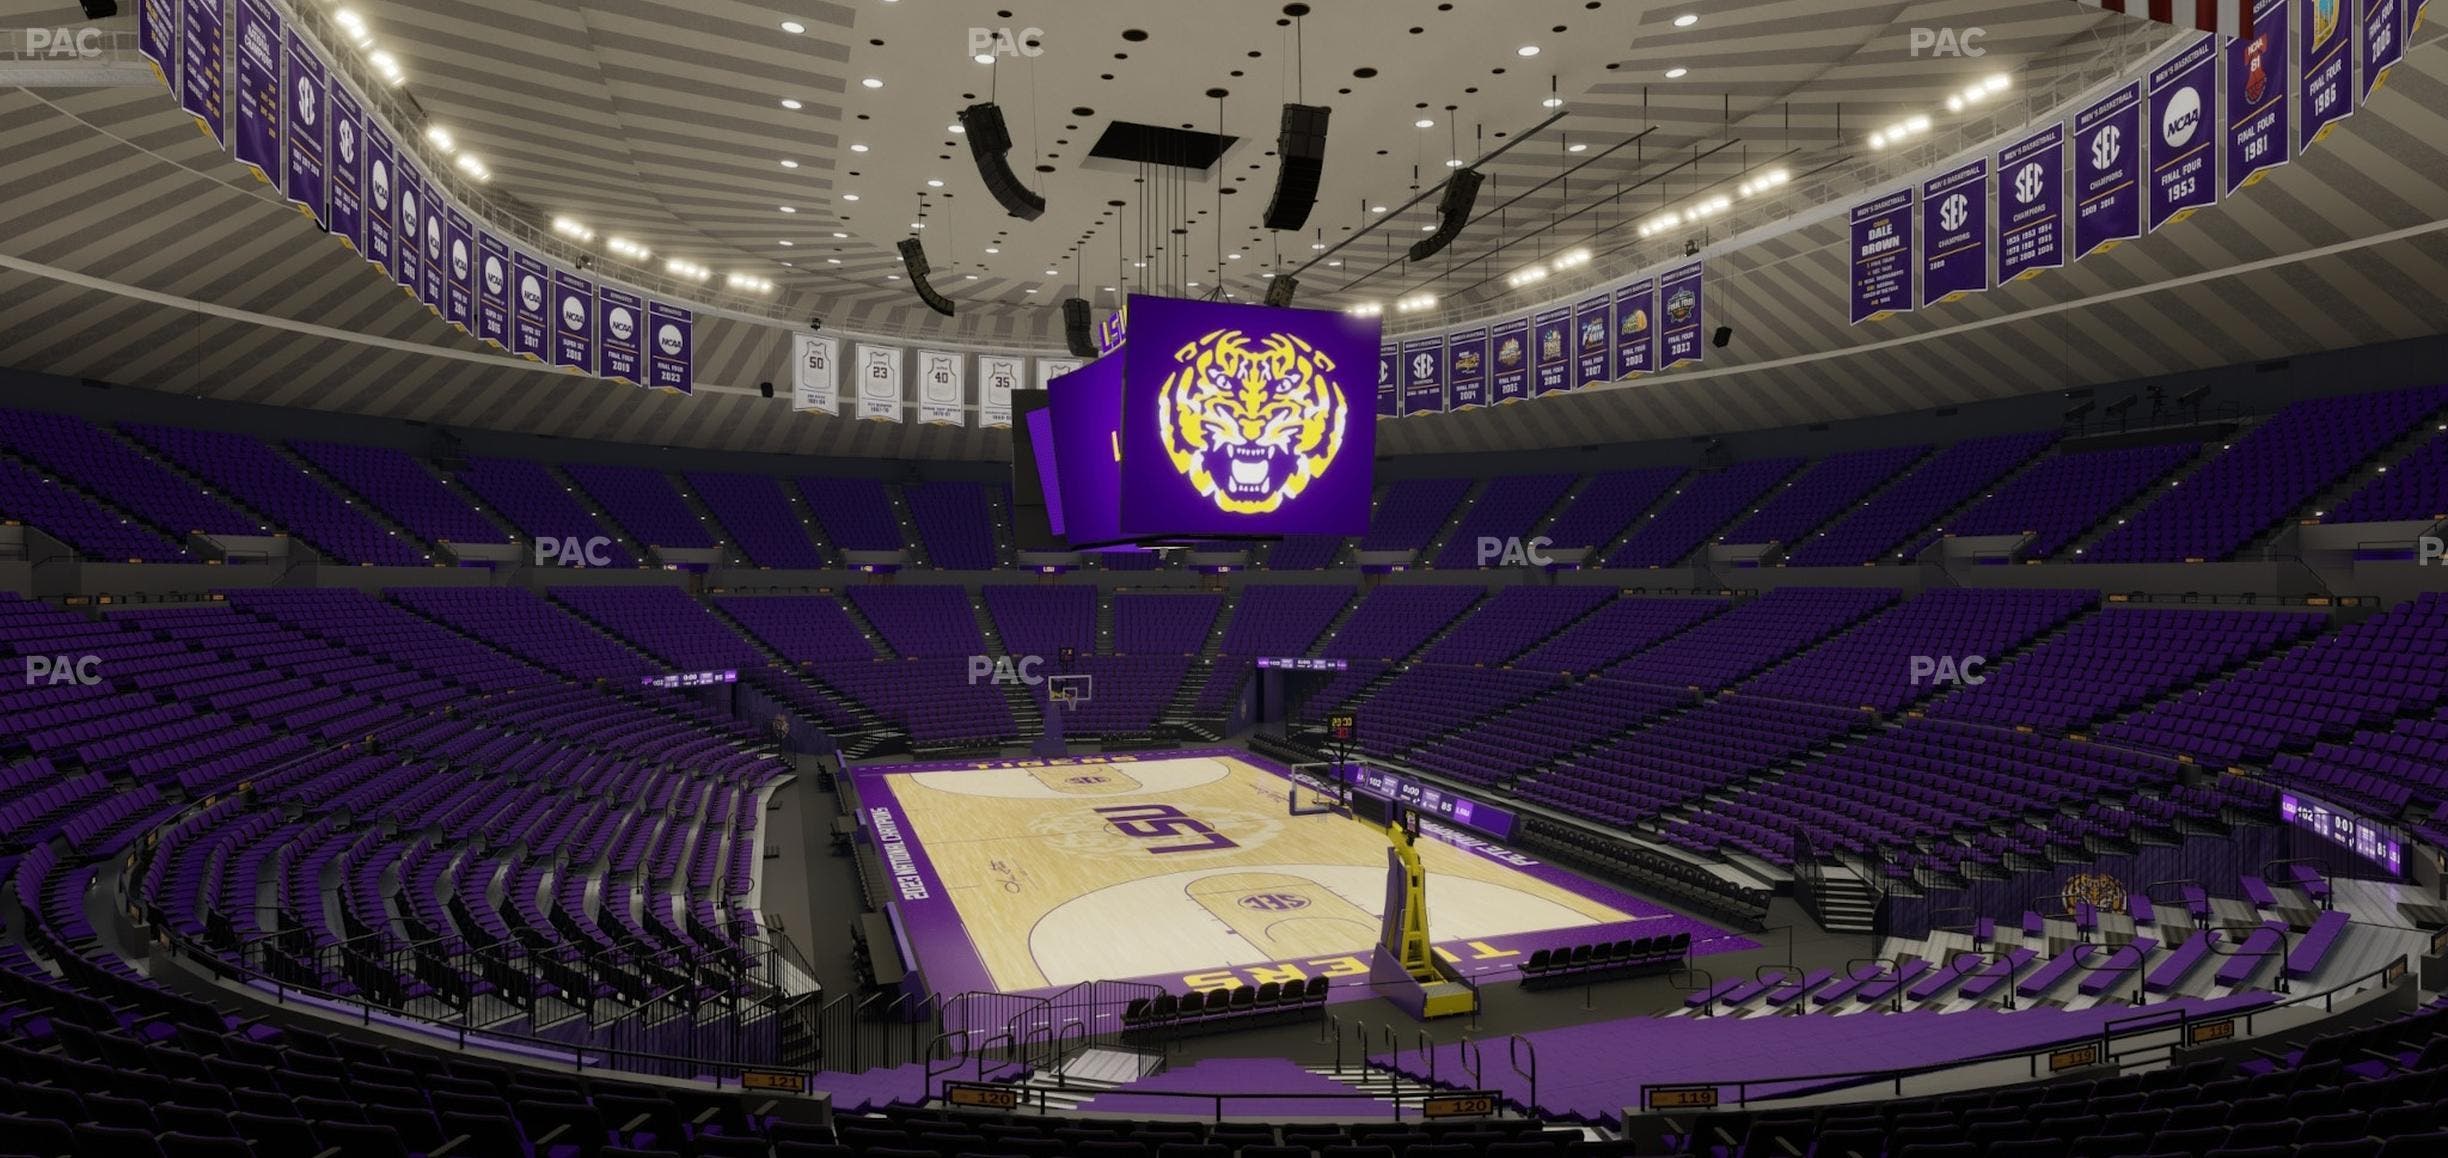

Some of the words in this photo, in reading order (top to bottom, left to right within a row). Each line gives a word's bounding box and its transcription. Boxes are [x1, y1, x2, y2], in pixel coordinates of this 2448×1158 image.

[2155, 66, 2174, 84] MEN'S
[2174, 43, 2209, 74] BASKETBALL
[2309, 76, 2325, 96] FINAL
[2326, 59, 2342, 80] FOUR
[2315, 83, 2337, 116] 1986
[2166, 109, 2200, 137] NCAA
[2237, 126, 2255, 145] FINAL
[2257, 113, 2276, 132] FOUR
[2091, 124, 2120, 170] SEC
[2244, 135, 2267, 162] 1981
[2160, 169, 2180, 187] FINAL
[2182, 157, 2202, 175] FOUR
[2015, 162, 2043, 203] SEC
[2168, 176, 2195, 203] 1953
[1940, 194, 1968, 231] SEC
[1868, 223, 1893, 241] DALE
[1862, 235, 1900, 257] BROWN
[488, 273, 502, 286] NCAA
[524, 290, 541, 304] NCAA
[566, 311, 584, 323] NCAA
[612, 322, 632, 333] NCAA
[661, 337, 682, 350] NCAA
[809, 356, 824, 370] 50
[1413, 353, 1434, 379] SEC
[662, 371, 681, 383] 2023
[873, 366, 888, 379] 23
[934, 372, 949, 384] 40
[995, 376, 1011, 388] 35
[1369, 776, 1383, 787] 102
[1402, 784, 1420, 796] 0:00
[1440, 801, 1452, 812] 85
[1455, 805, 1471, 817] LSU
[2297, 807, 2314, 822] 102
[1093, 804, 1241, 855] LSU
[897, 875, 929, 900] 2023
[1244, 894, 1306, 910] SEC
[1183, 944, 1521, 993] TIERS
[769, 1074, 799, 1088] 121
[979, 1092, 1010, 1105] 120
[1678, 1092, 1711, 1105] 119
[1453, 1101, 1487, 1113] 120
